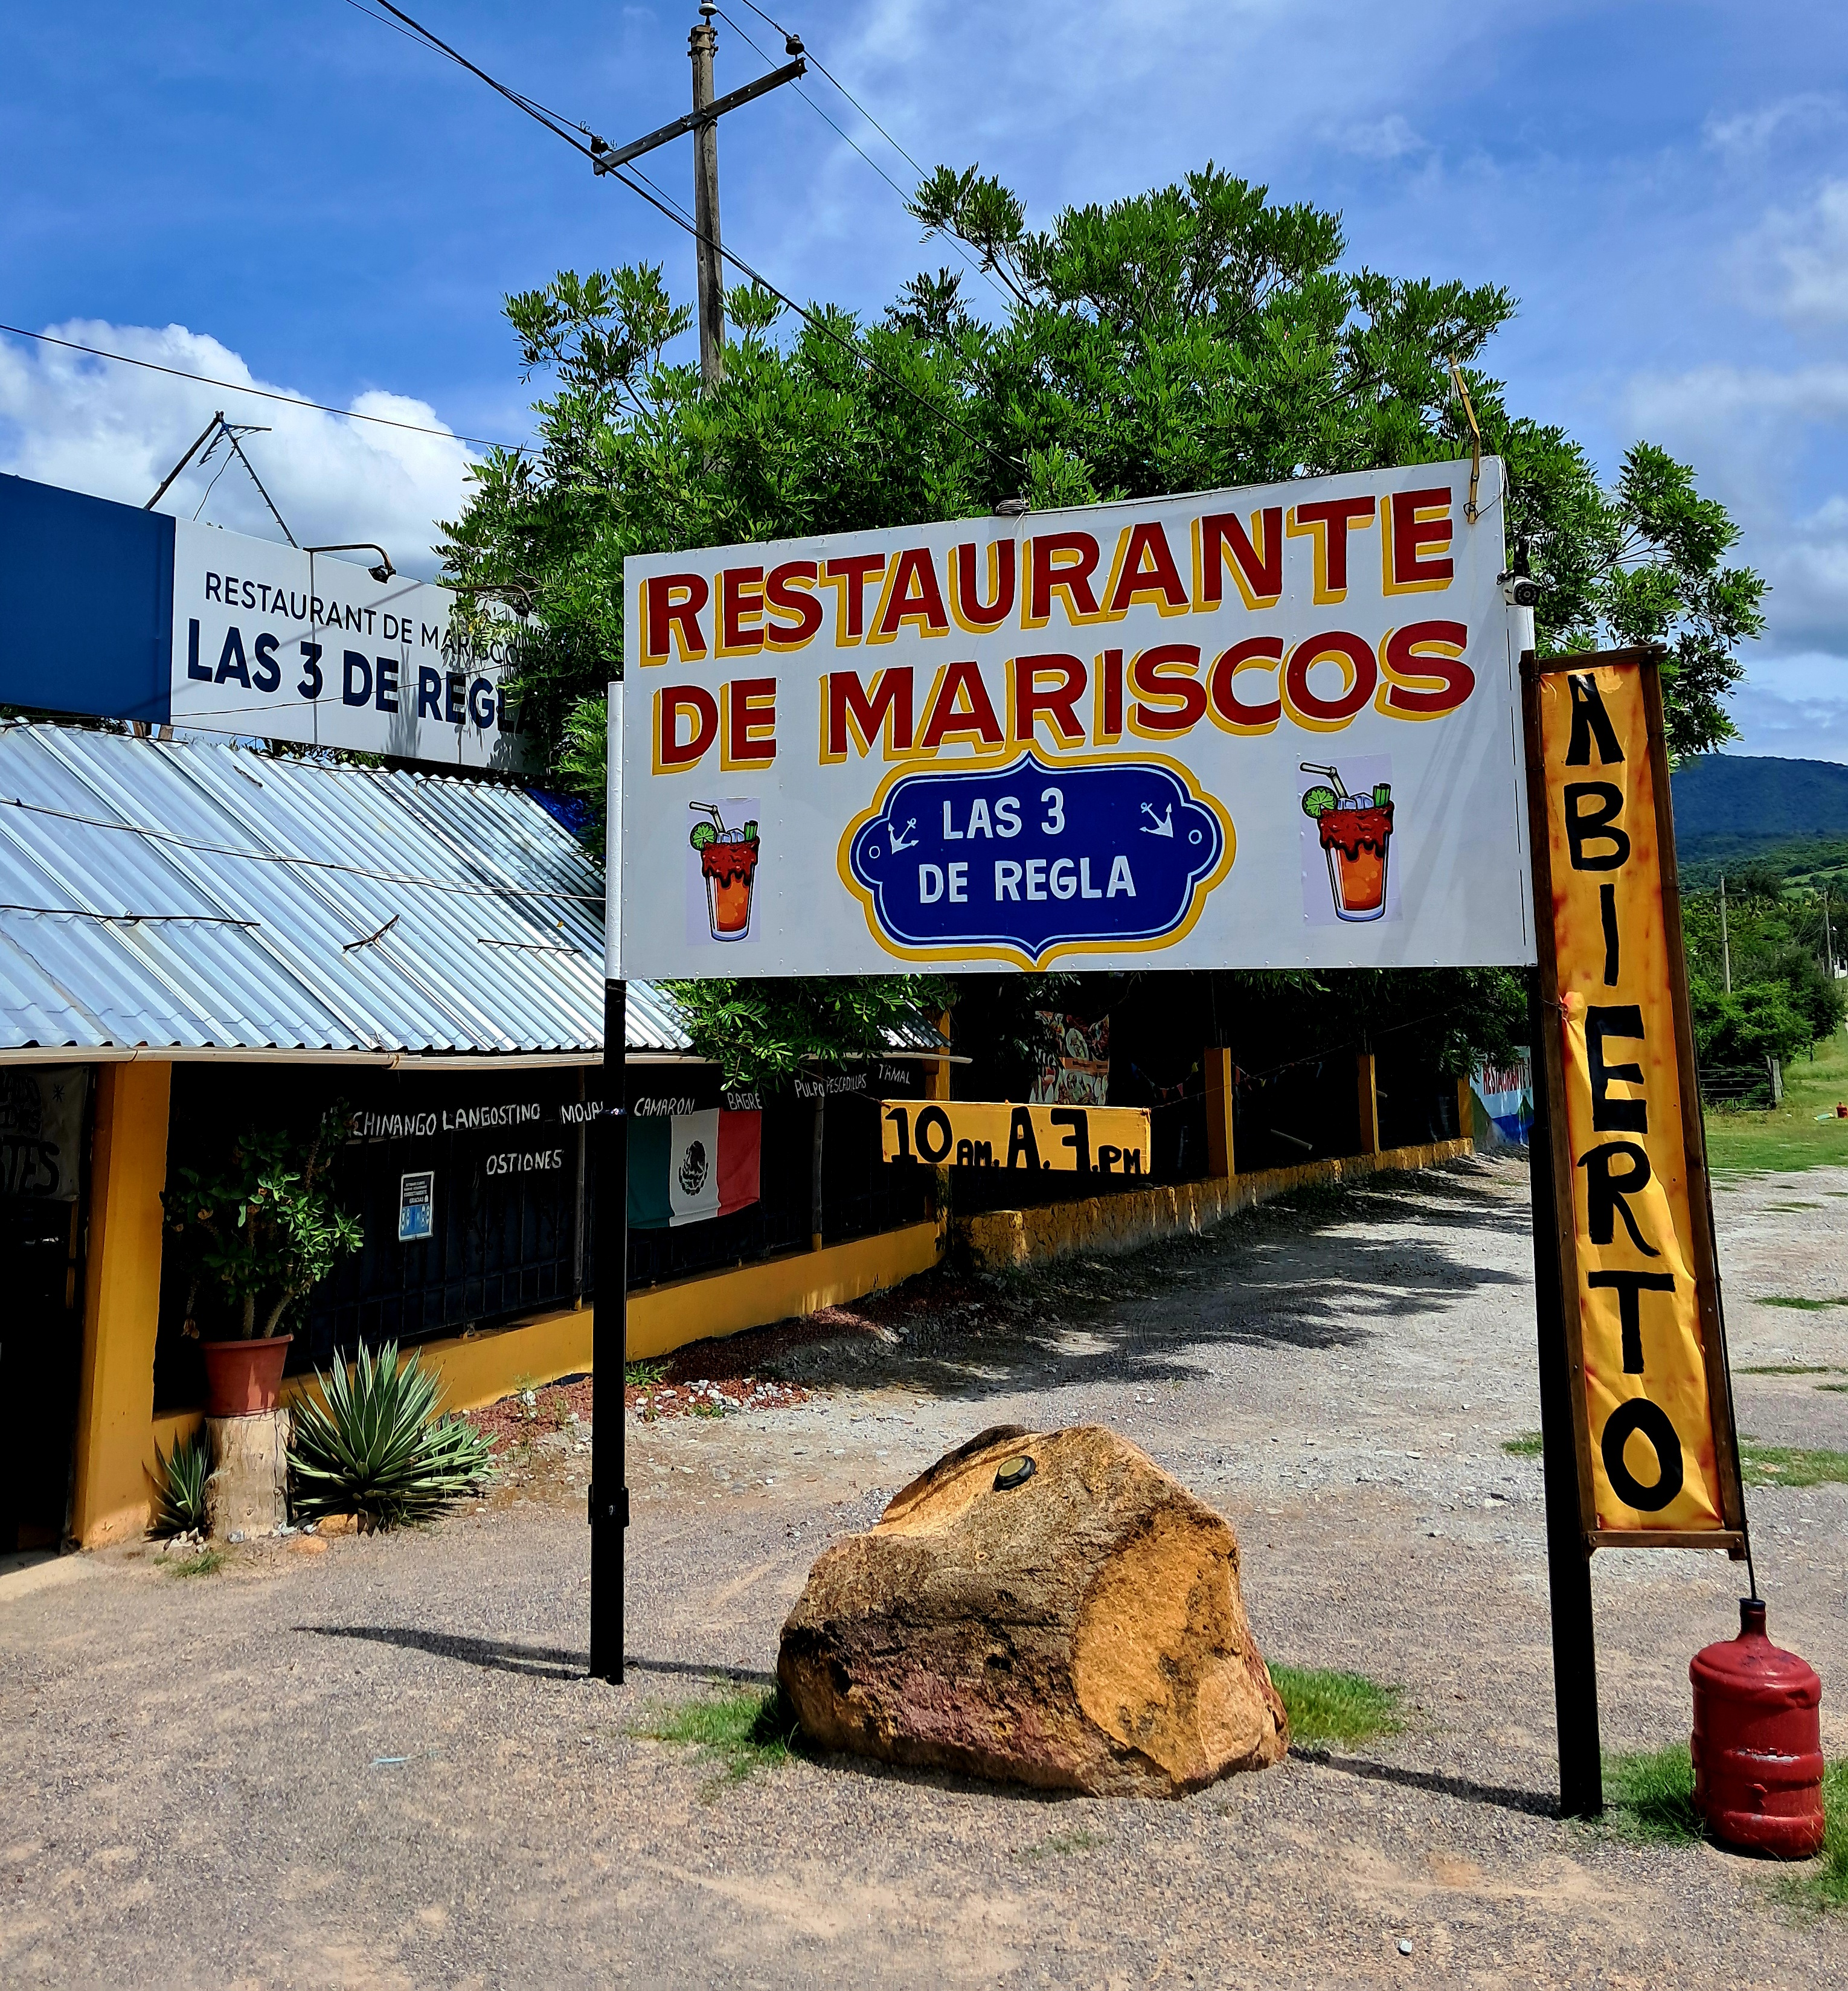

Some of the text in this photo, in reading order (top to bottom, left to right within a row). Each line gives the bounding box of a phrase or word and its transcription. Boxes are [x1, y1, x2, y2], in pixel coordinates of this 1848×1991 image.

[639, 486, 1455, 668] RESTAURANTE
[205, 571, 377, 636] RESTAURANT
[383, 613, 413, 645] DE
[187, 617, 524, 736] LAS 3 DE REGL
[652, 619, 1475, 776] DE MARISCOS
[943, 787, 1065, 840] LAS 3
[919, 854, 1137, 903] DE REGLA
[634, 1092, 763, 1117] CAMARON BAGRE
[794, 1079, 826, 1098] PULPO
[1564, 672, 1684, 1513] ABIERTO
[442, 1102, 541, 1130] LANGOSTINO
[486, 1149, 563, 1175] OSTIONES
